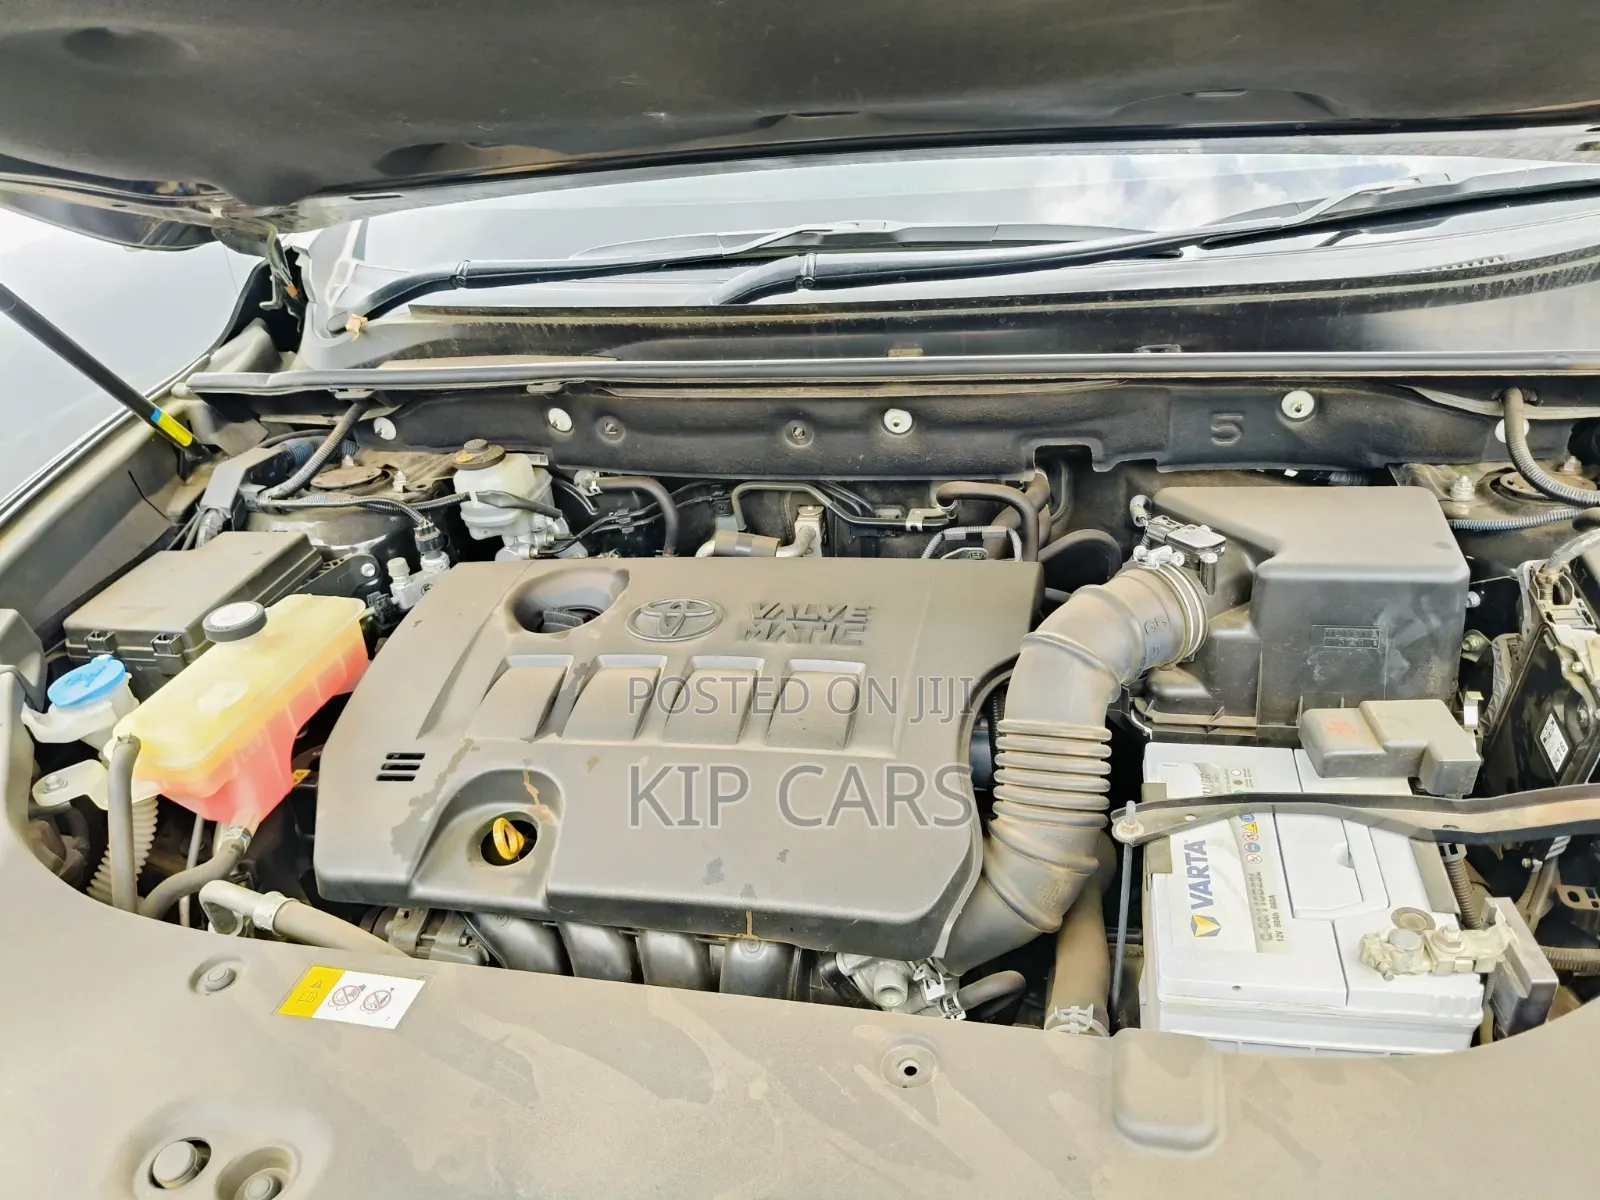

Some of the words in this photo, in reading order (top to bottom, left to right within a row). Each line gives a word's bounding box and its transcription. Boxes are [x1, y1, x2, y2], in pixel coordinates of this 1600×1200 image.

[1210, 412, 1245, 447] 5
[749, 602, 869, 624] VALVE
[744, 619, 864, 646] MATIC
[1184, 840, 1214, 909] VARTA
[1275, 929, 1285, 942] 12V
